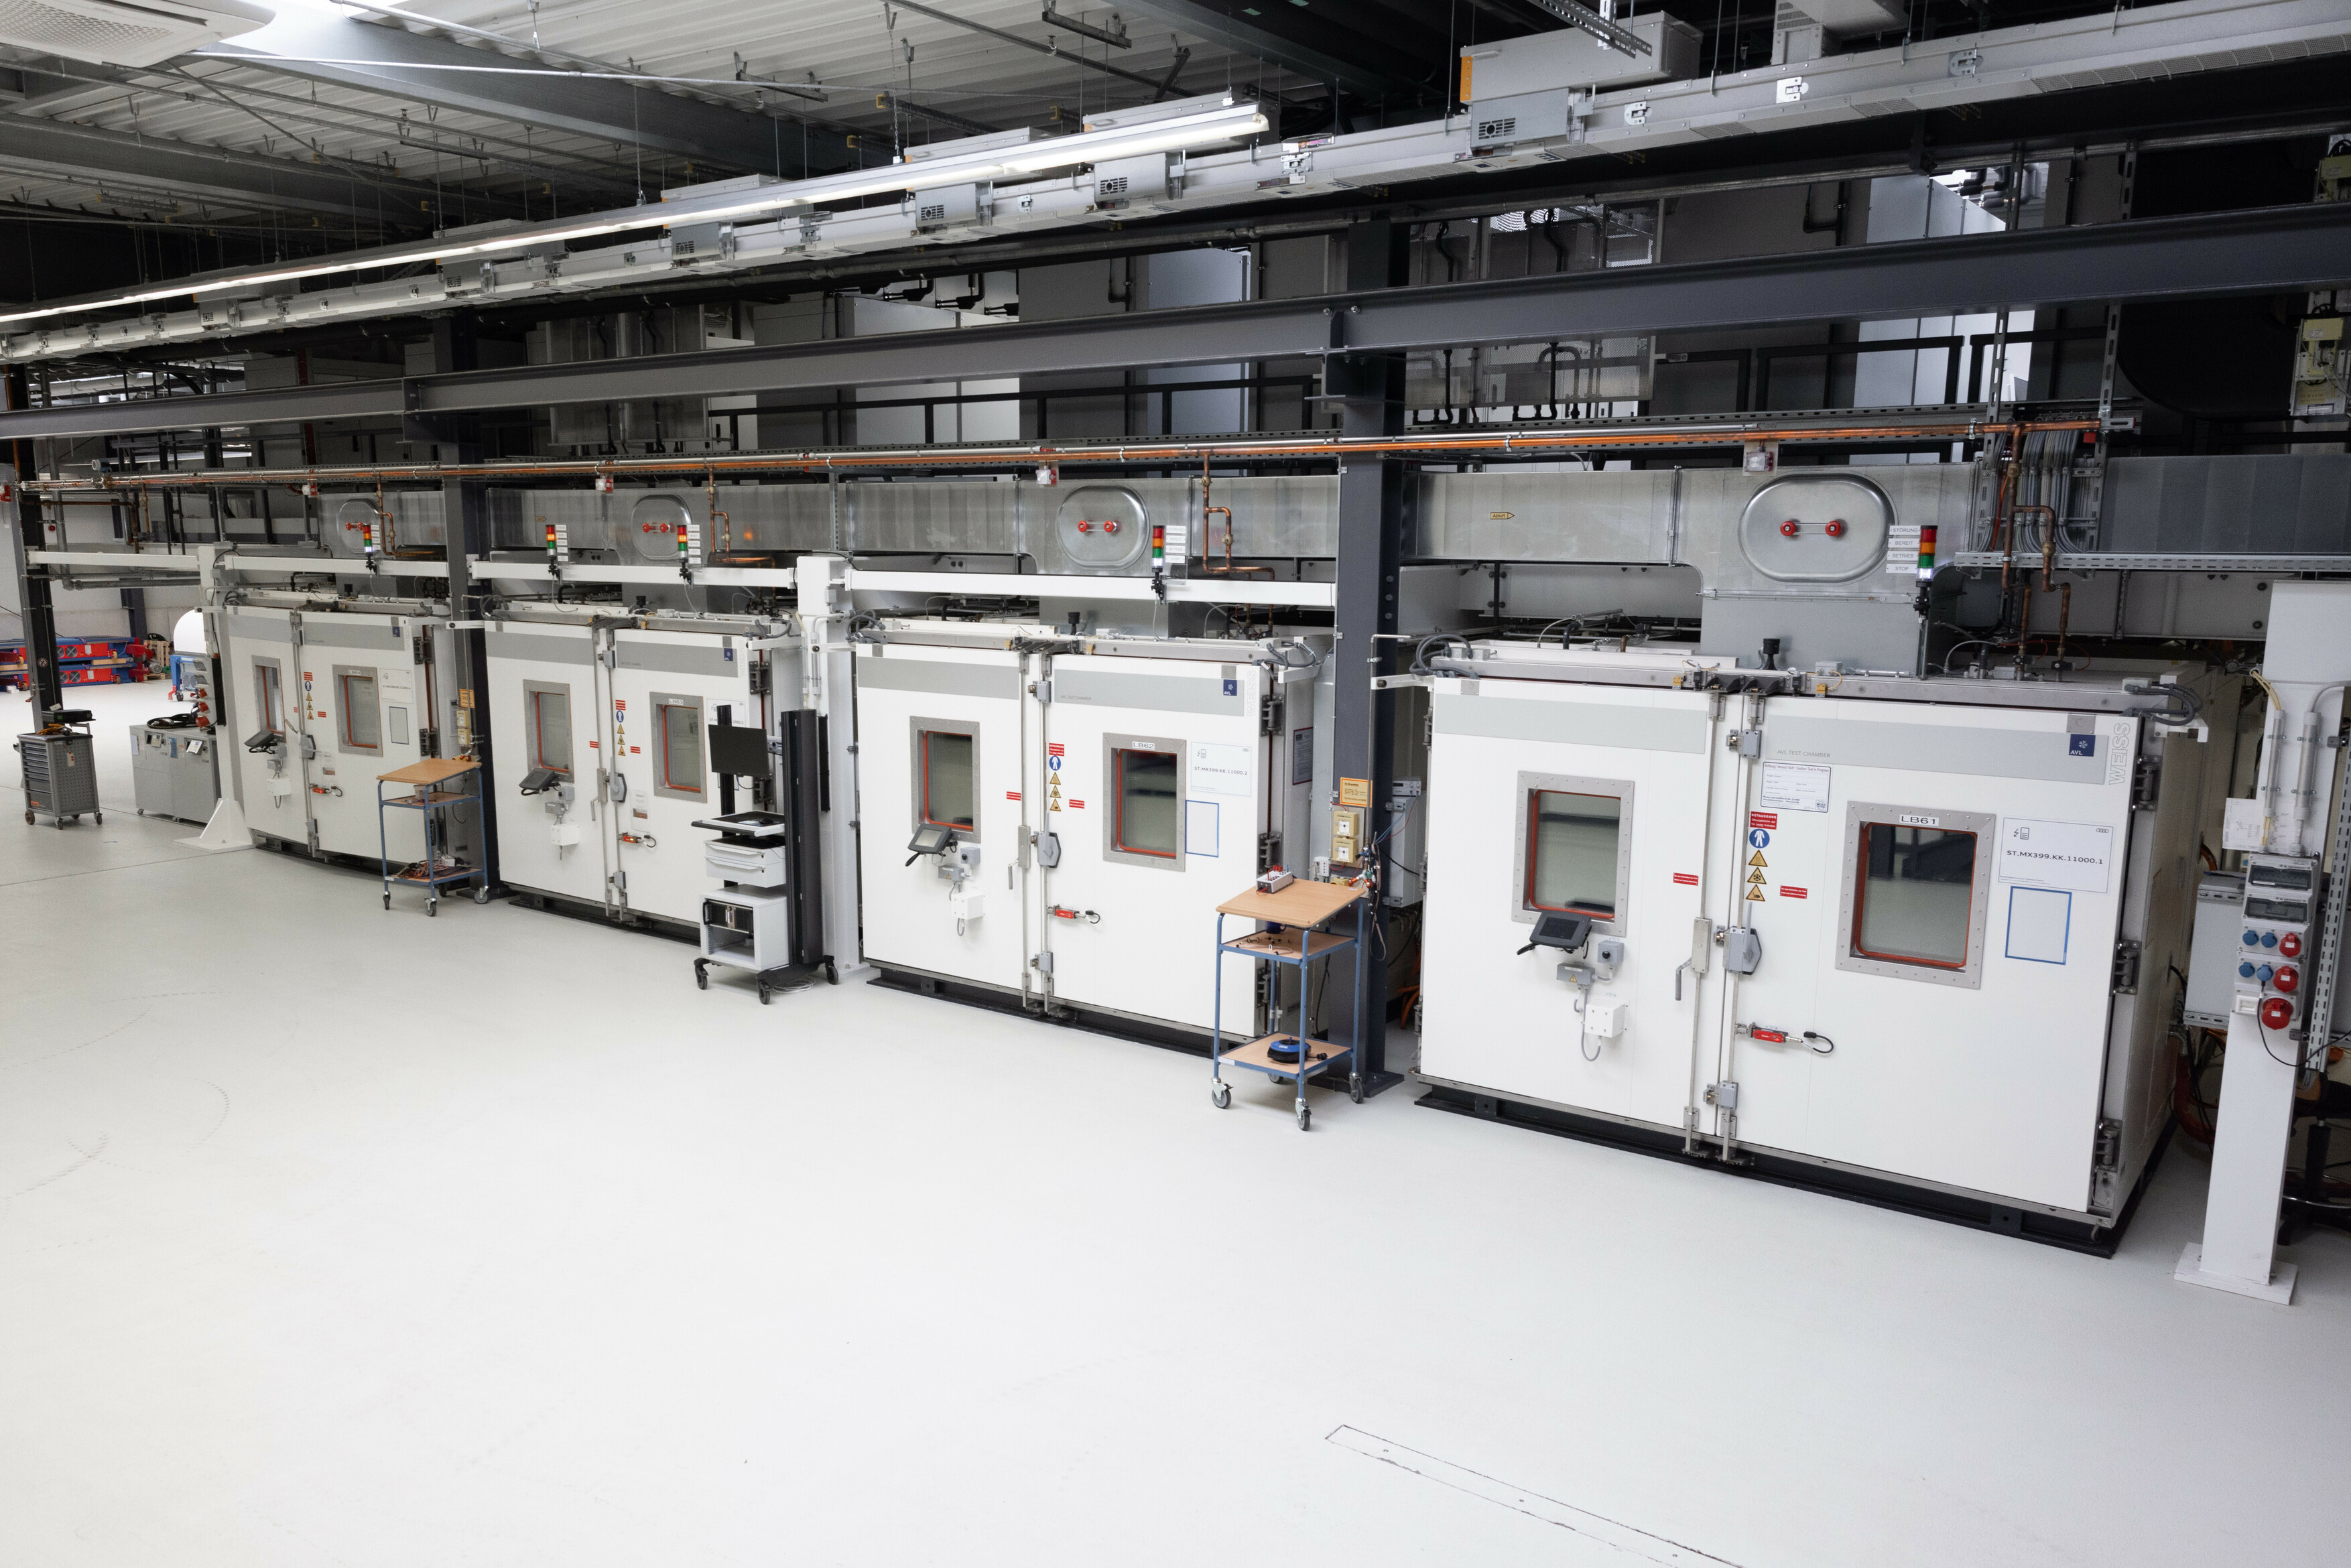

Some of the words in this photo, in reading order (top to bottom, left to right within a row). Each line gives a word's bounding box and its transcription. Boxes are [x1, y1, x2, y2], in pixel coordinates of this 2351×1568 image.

[1246, 669, 1257, 716] WEISS
[2108, 722, 2131, 785] WEISS
[1194, 766, 1248, 775] ST.MX399.KK.11000.2
[1901, 815, 1935, 824] LB61
[2007, 850, 2103, 864] ST.MX399.KK.11000.1
